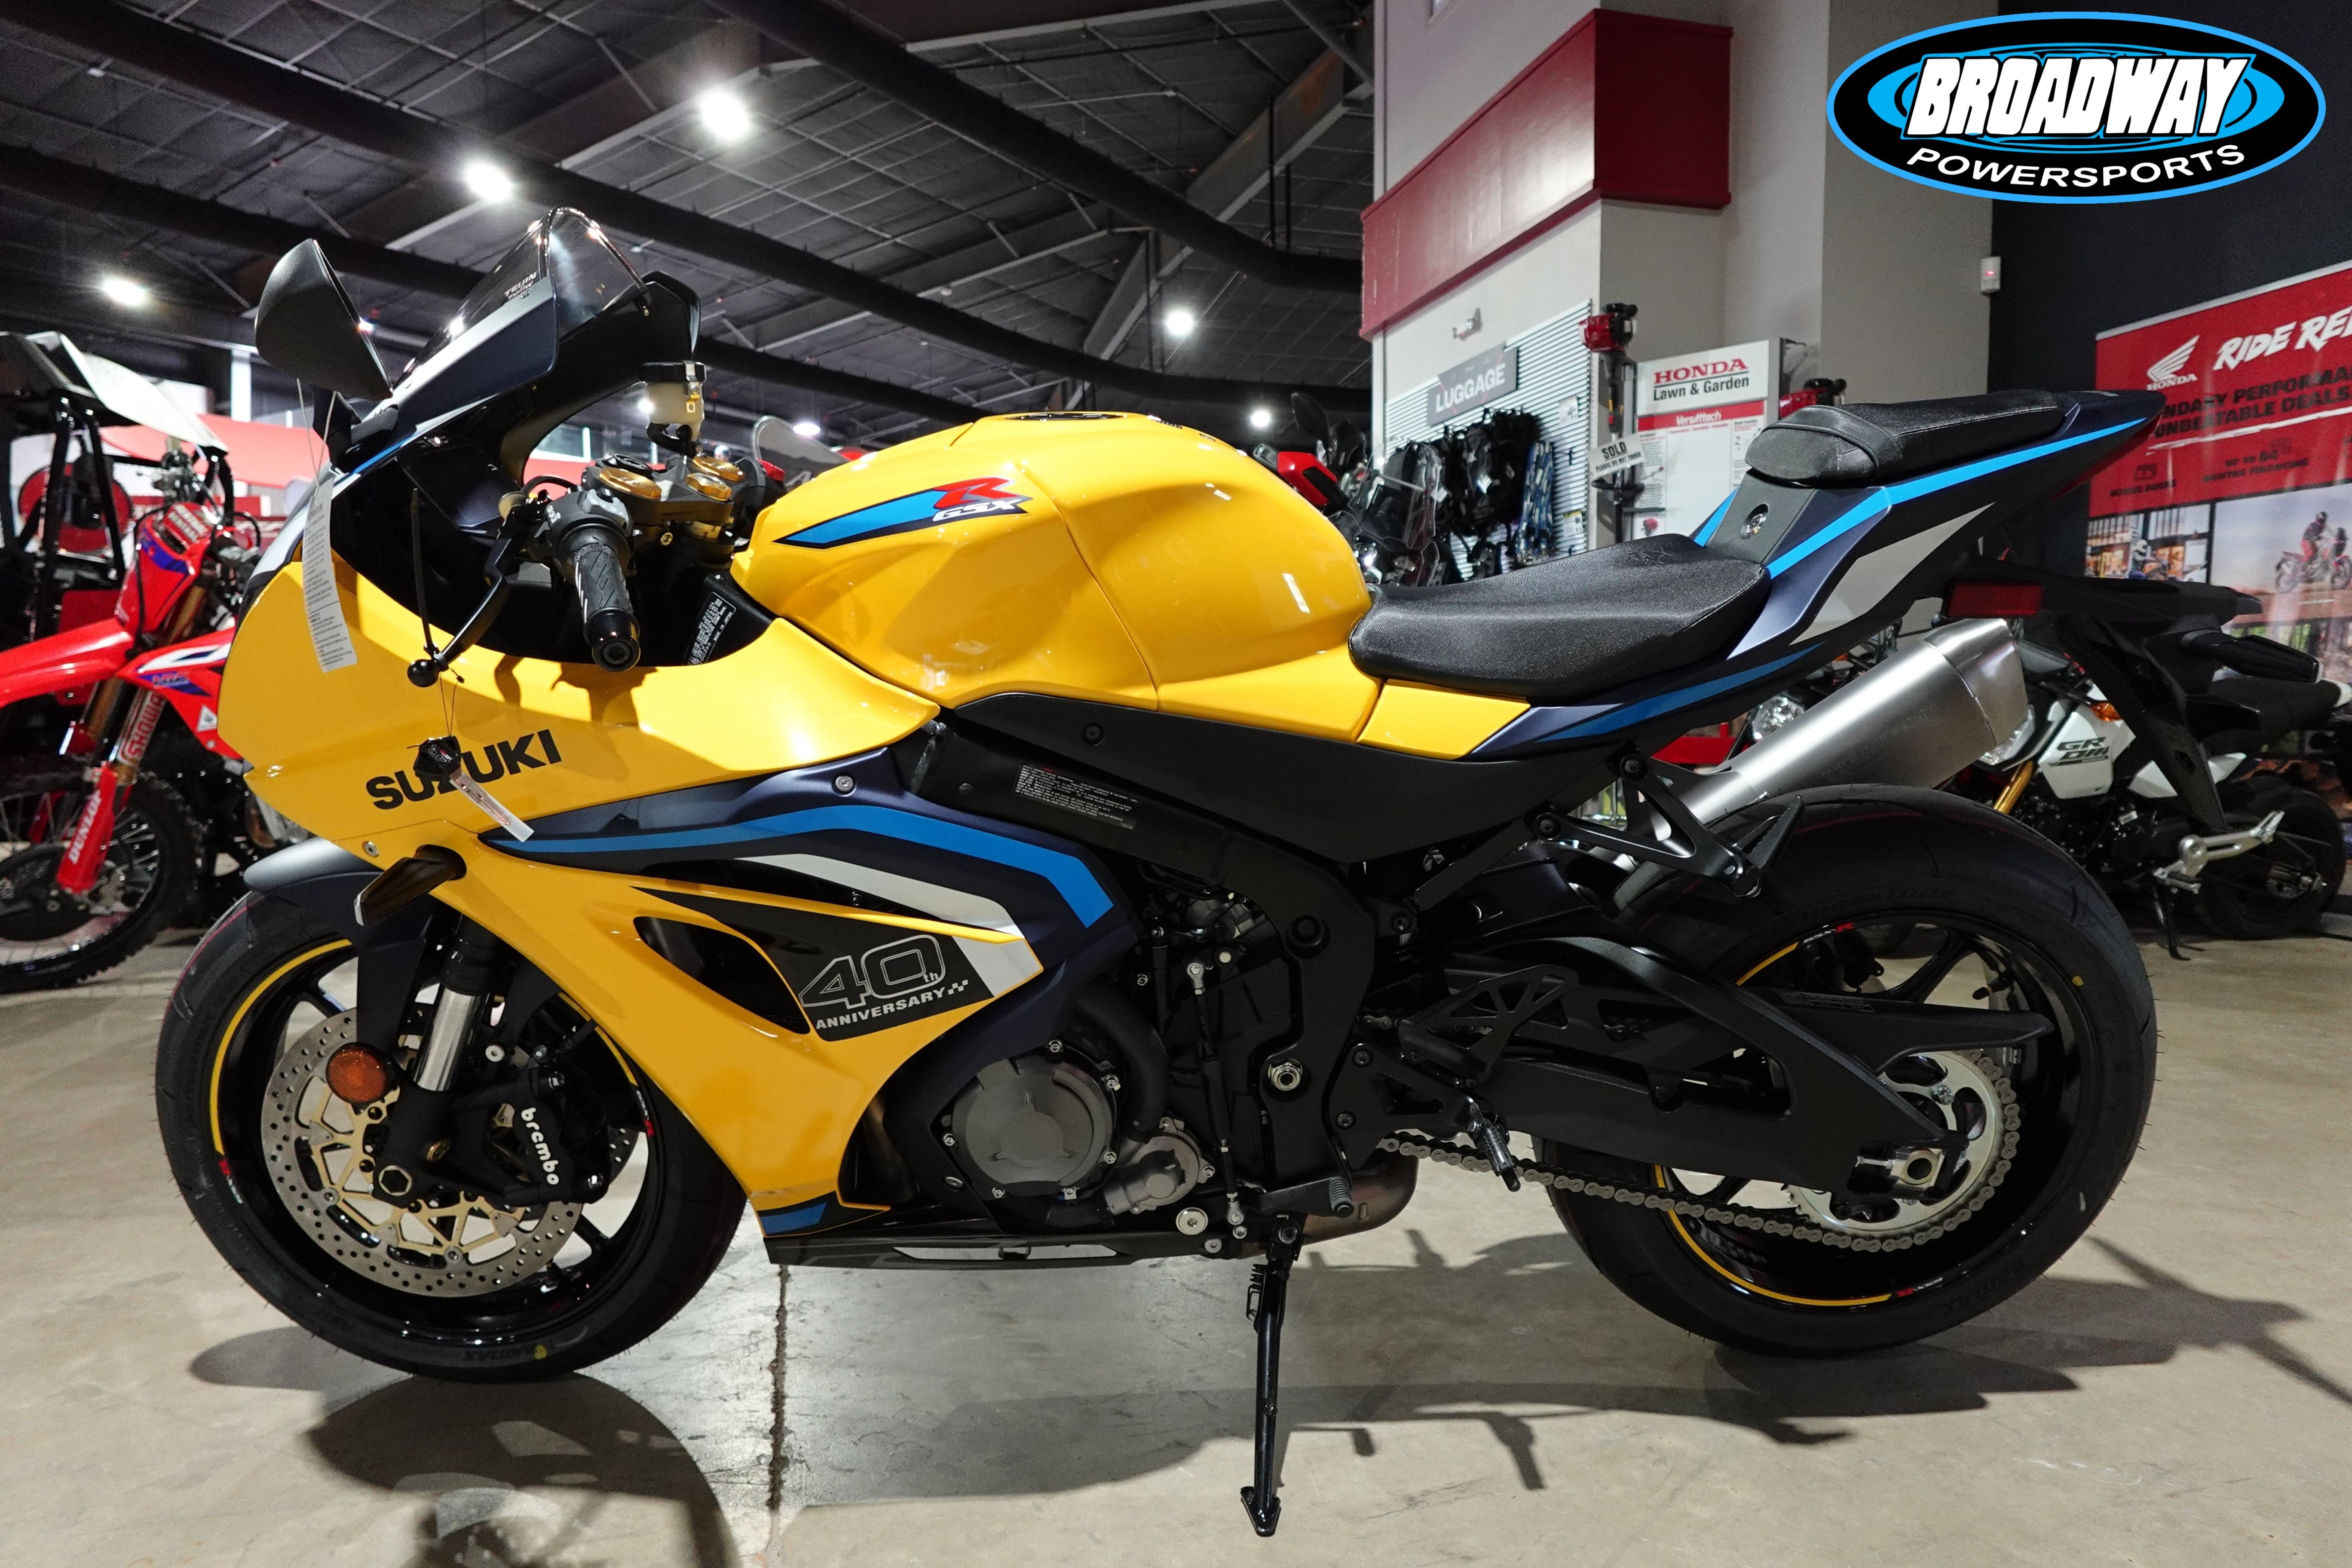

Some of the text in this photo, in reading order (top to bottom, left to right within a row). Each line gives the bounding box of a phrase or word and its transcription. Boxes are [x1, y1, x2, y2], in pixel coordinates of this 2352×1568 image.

[2213, 321, 2297, 371] RIDE
[1436, 363, 1506, 413] LUGGAGE
[1654, 358, 1748, 384] HONDA
[1654, 377, 1749, 401] Lawn & Garden
[2146, 373, 2198, 391] HONDA
[2233, 365, 2352, 404] PERFORMA
[1602, 441, 1627, 459] SOLD
[932, 499, 1023, 522] GSX
[124, 693, 165, 759] SHOWA
[798, 934, 946, 1009] 40 th
[816, 986, 946, 1030] ANNIVERSARY
[520, 1106, 560, 1229] brembo
